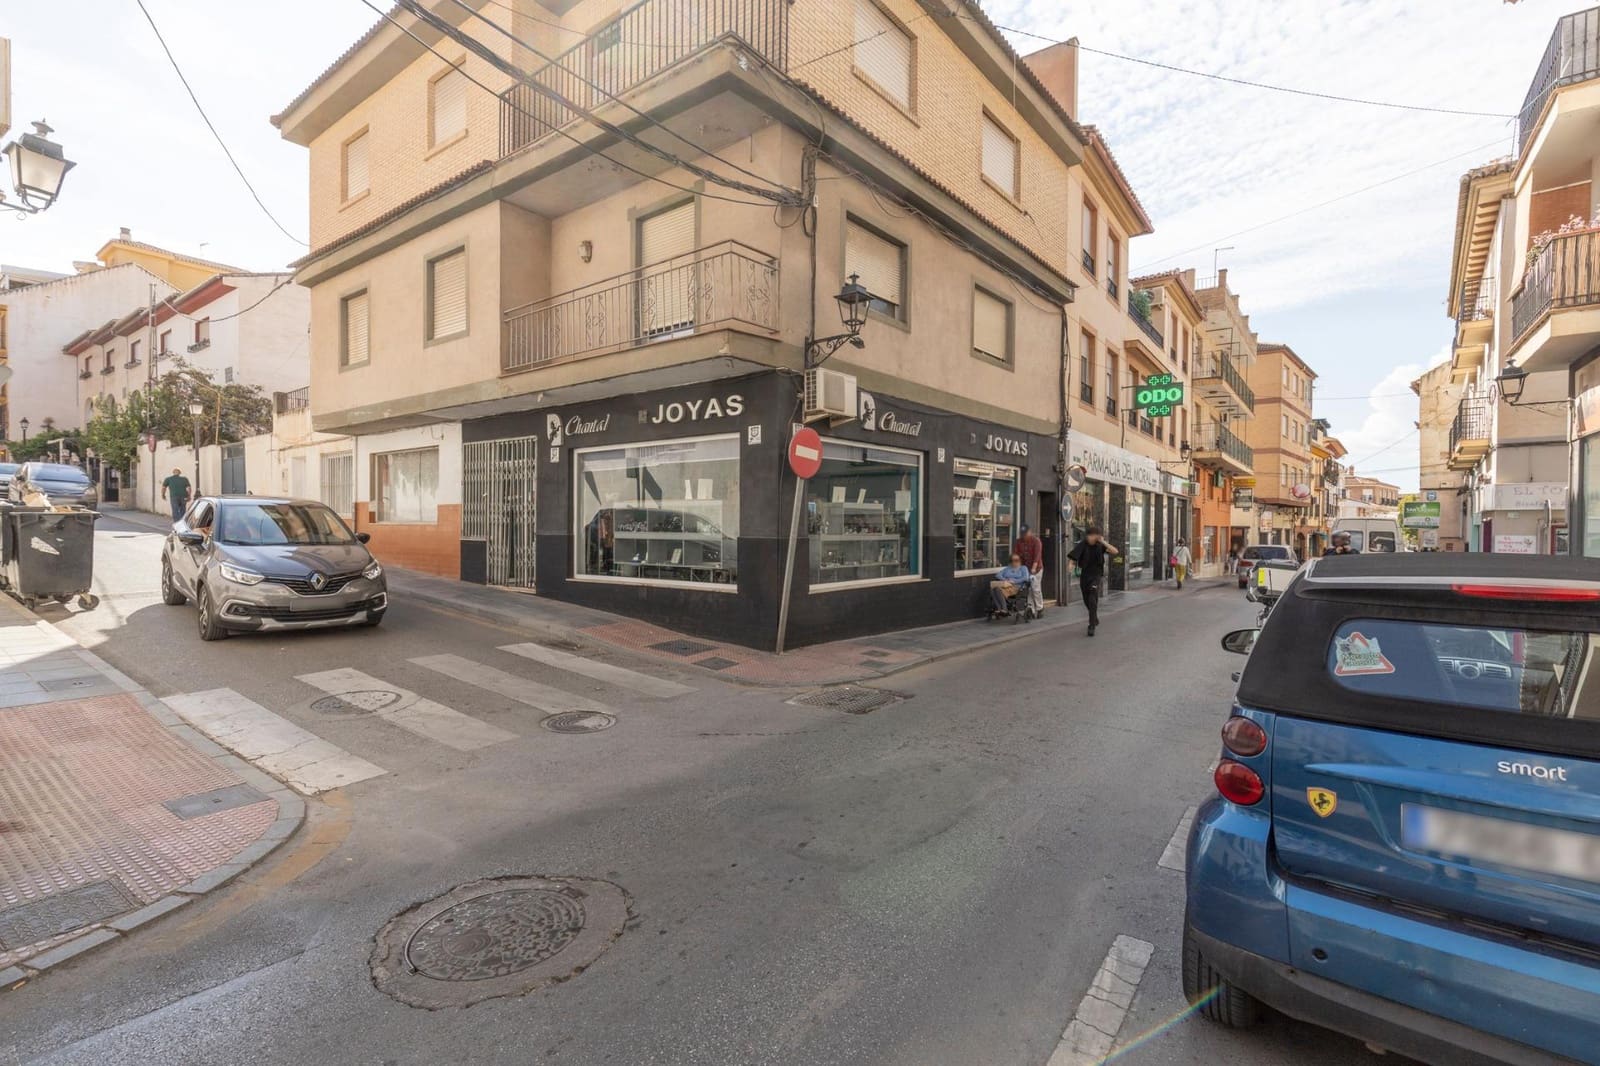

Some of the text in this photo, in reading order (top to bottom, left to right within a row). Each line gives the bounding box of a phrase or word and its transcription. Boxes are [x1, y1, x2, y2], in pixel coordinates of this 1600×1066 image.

[1138, 388, 1181, 404] ODO
[652, 394, 744, 424] JOYAS
[564, 413, 611, 437] Chantal
[879, 411, 922, 437] Chantal
[985, 434, 1029, 457] JOYAS
[1084, 451, 1152, 485] FARMACIA DEL MORAL
[1497, 760, 1567, 782] smart
